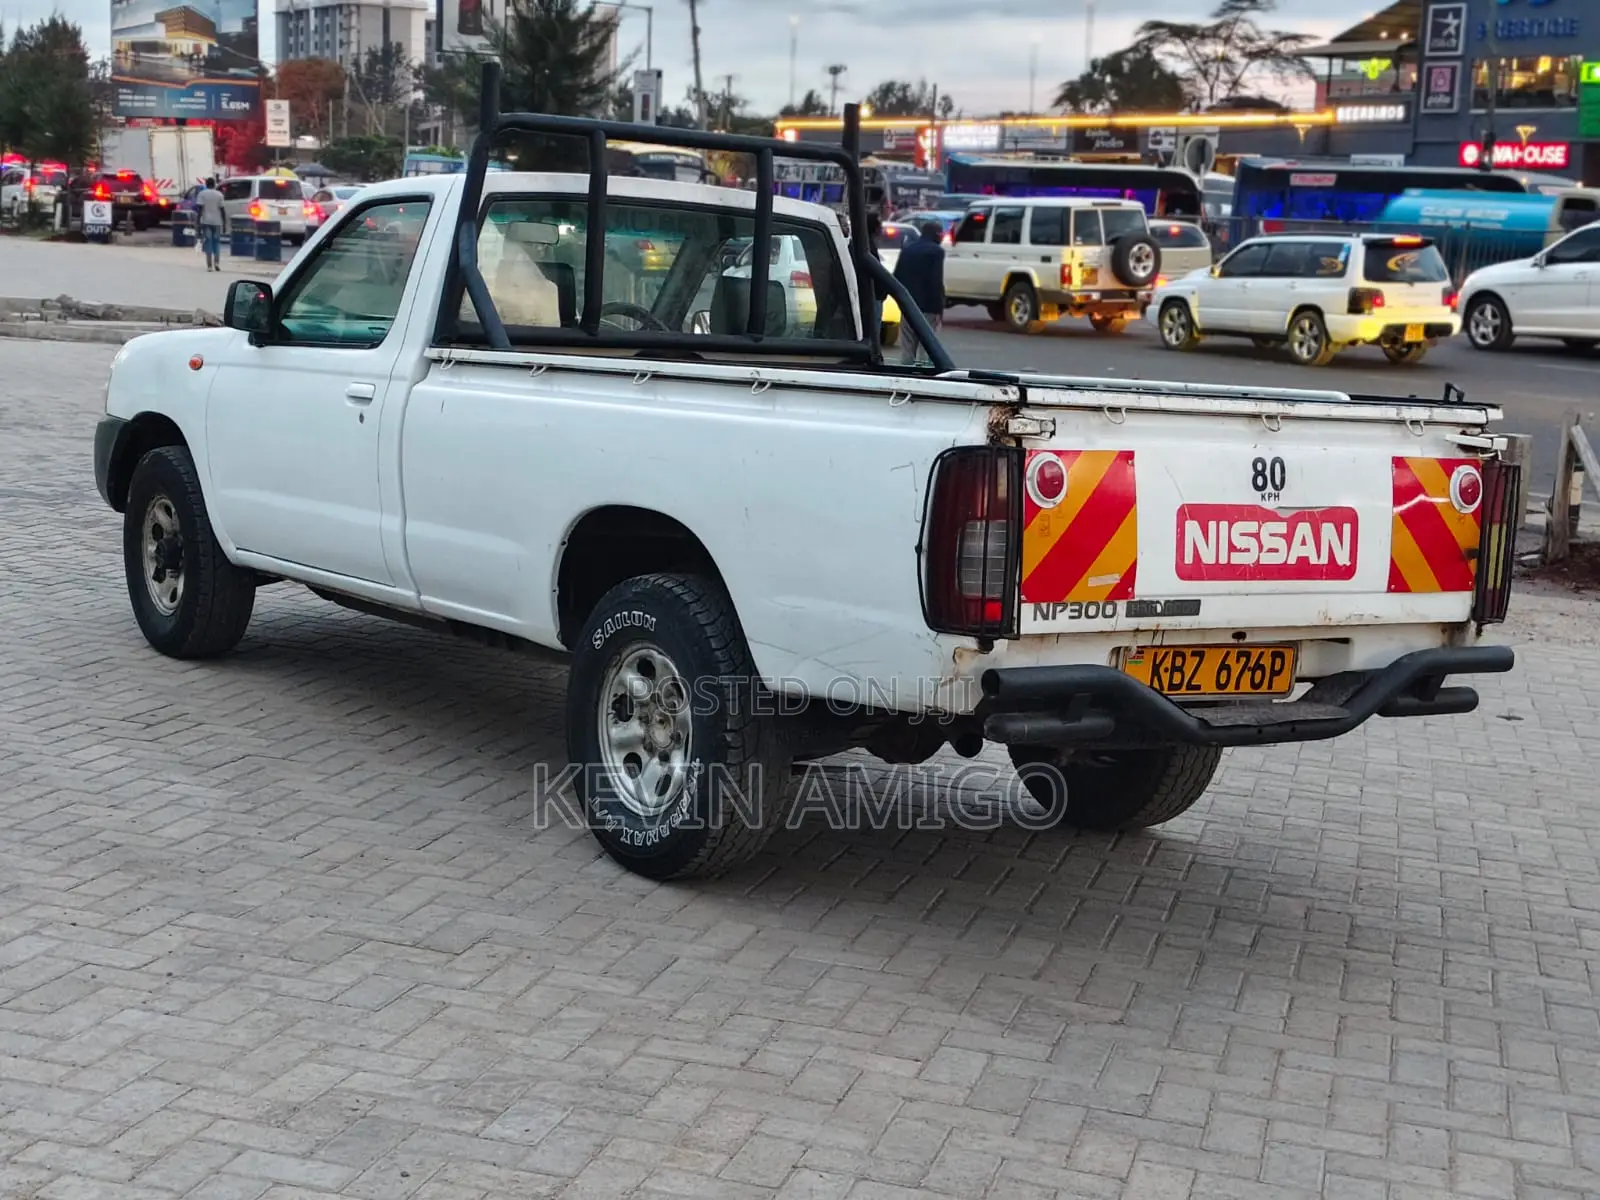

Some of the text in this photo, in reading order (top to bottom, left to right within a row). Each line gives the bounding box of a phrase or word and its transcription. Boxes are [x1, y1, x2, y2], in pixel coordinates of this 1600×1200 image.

[1252, 456, 1286, 492] 80
[1260, 492, 1280, 502] KPH
[1184, 520, 1352, 567] NISSAN
[591, 610, 657, 650] SAILUN
[1033, 601, 1118, 622] NP300
[1150, 649, 1286, 692] KBZ 676P
